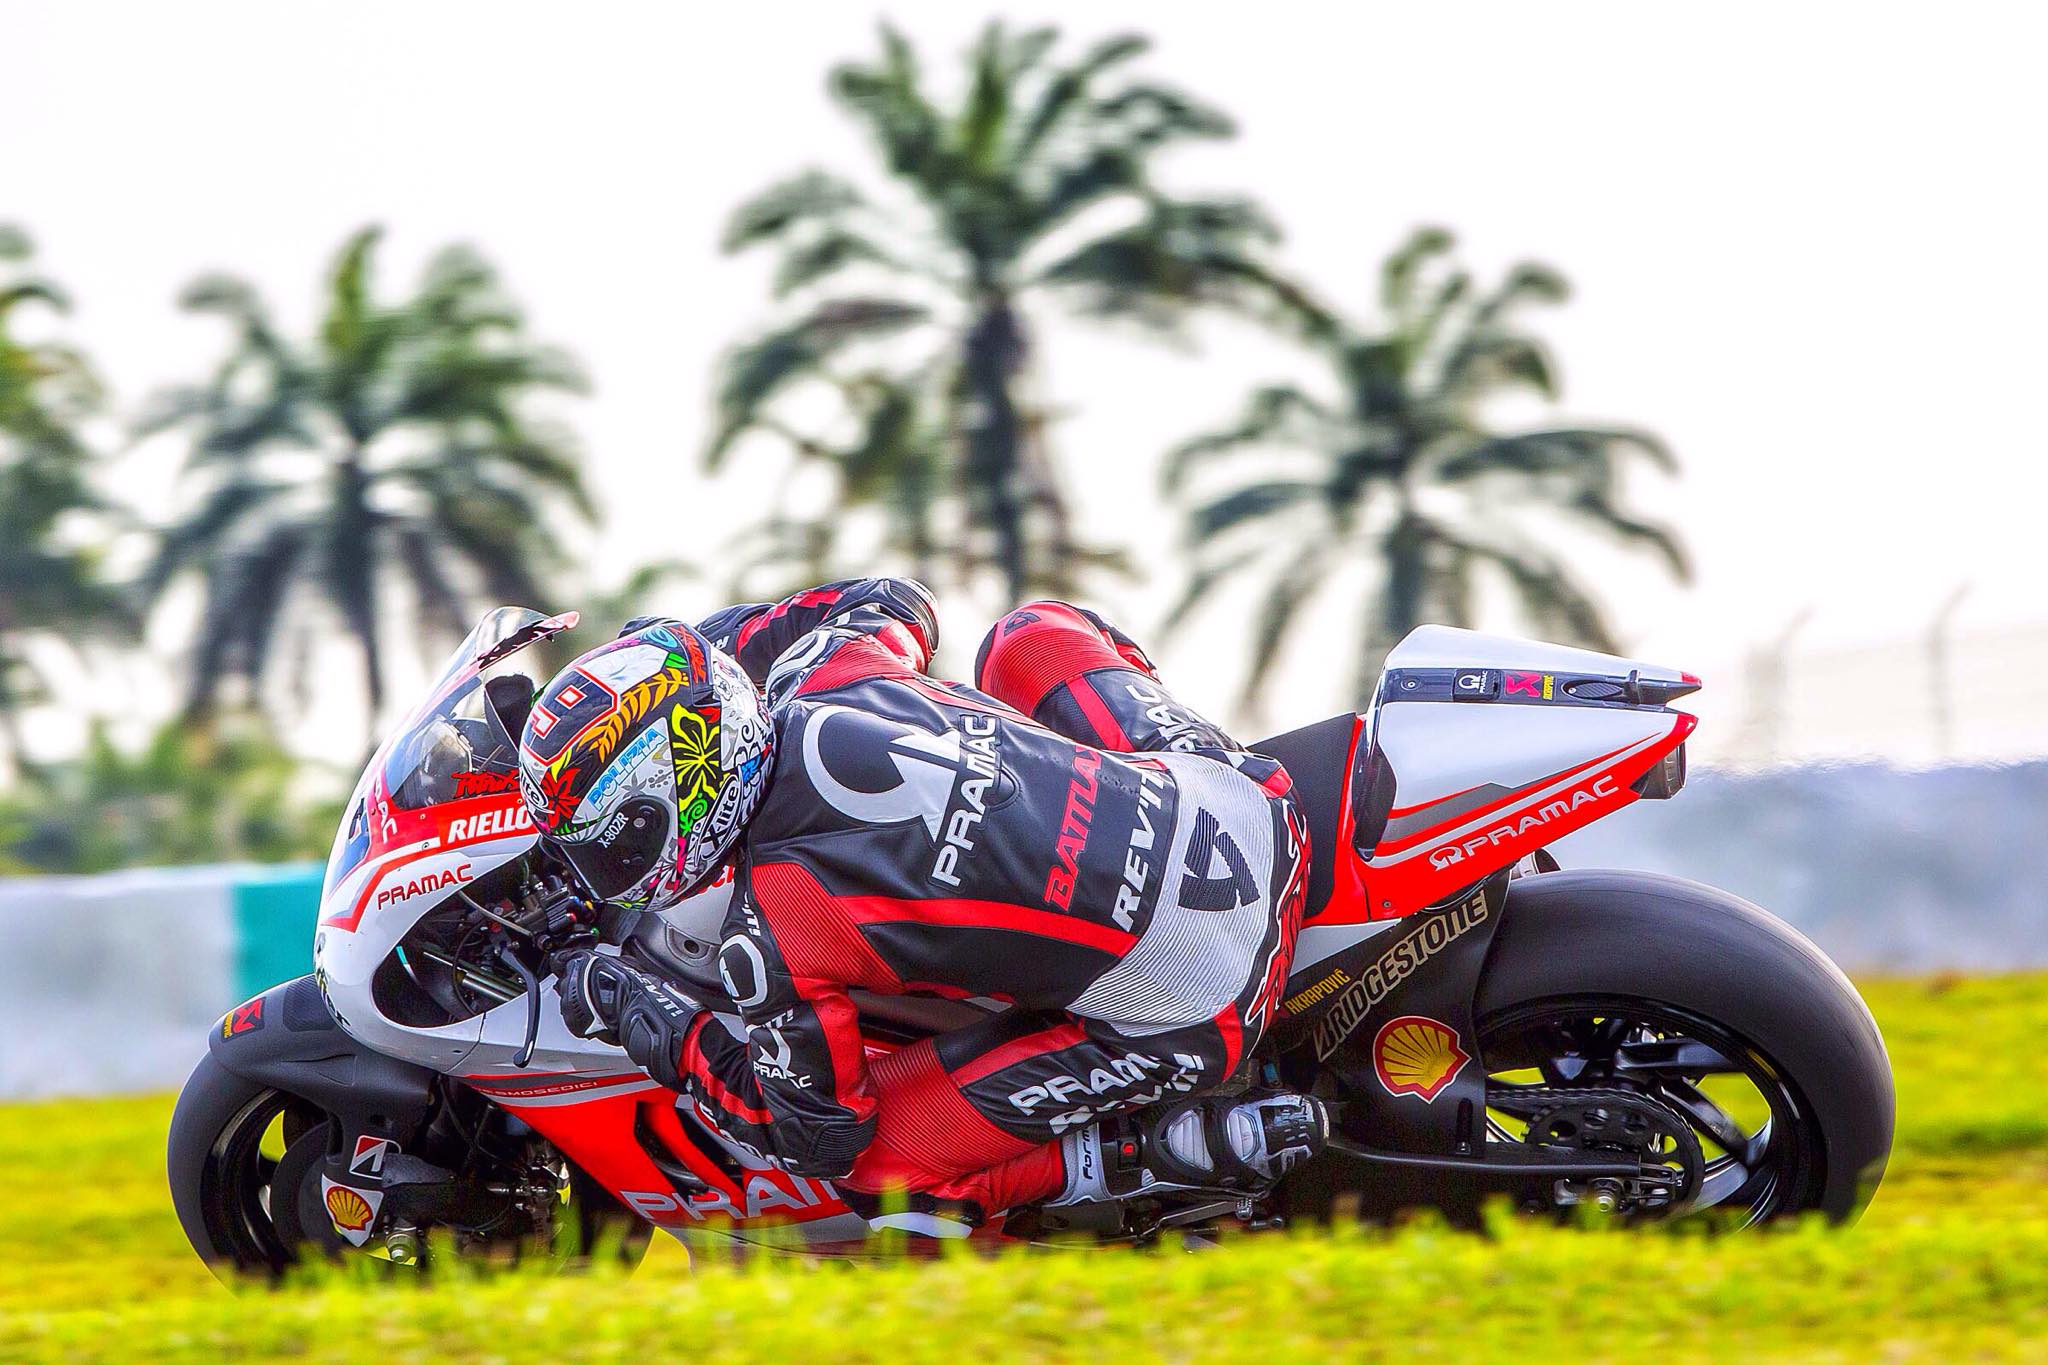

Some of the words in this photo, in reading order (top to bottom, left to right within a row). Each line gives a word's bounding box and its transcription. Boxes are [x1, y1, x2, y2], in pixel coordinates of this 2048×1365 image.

[586, 728, 668, 813] POLIZIA
[932, 716, 997, 887] PRAMAC
[447, 804, 534, 845] RIELLO
[597, 811, 629, 849] X-802R
[700, 785, 739, 852] X-lite
[1462, 775, 1619, 856] PRAMAC
[376, 863, 474, 911] PRAMAC
[1312, 889, 1489, 1062] BRIDGESTONE
[1008, 1052, 1161, 1116] PRAM
[1082, 1129, 1093, 1180] Form
